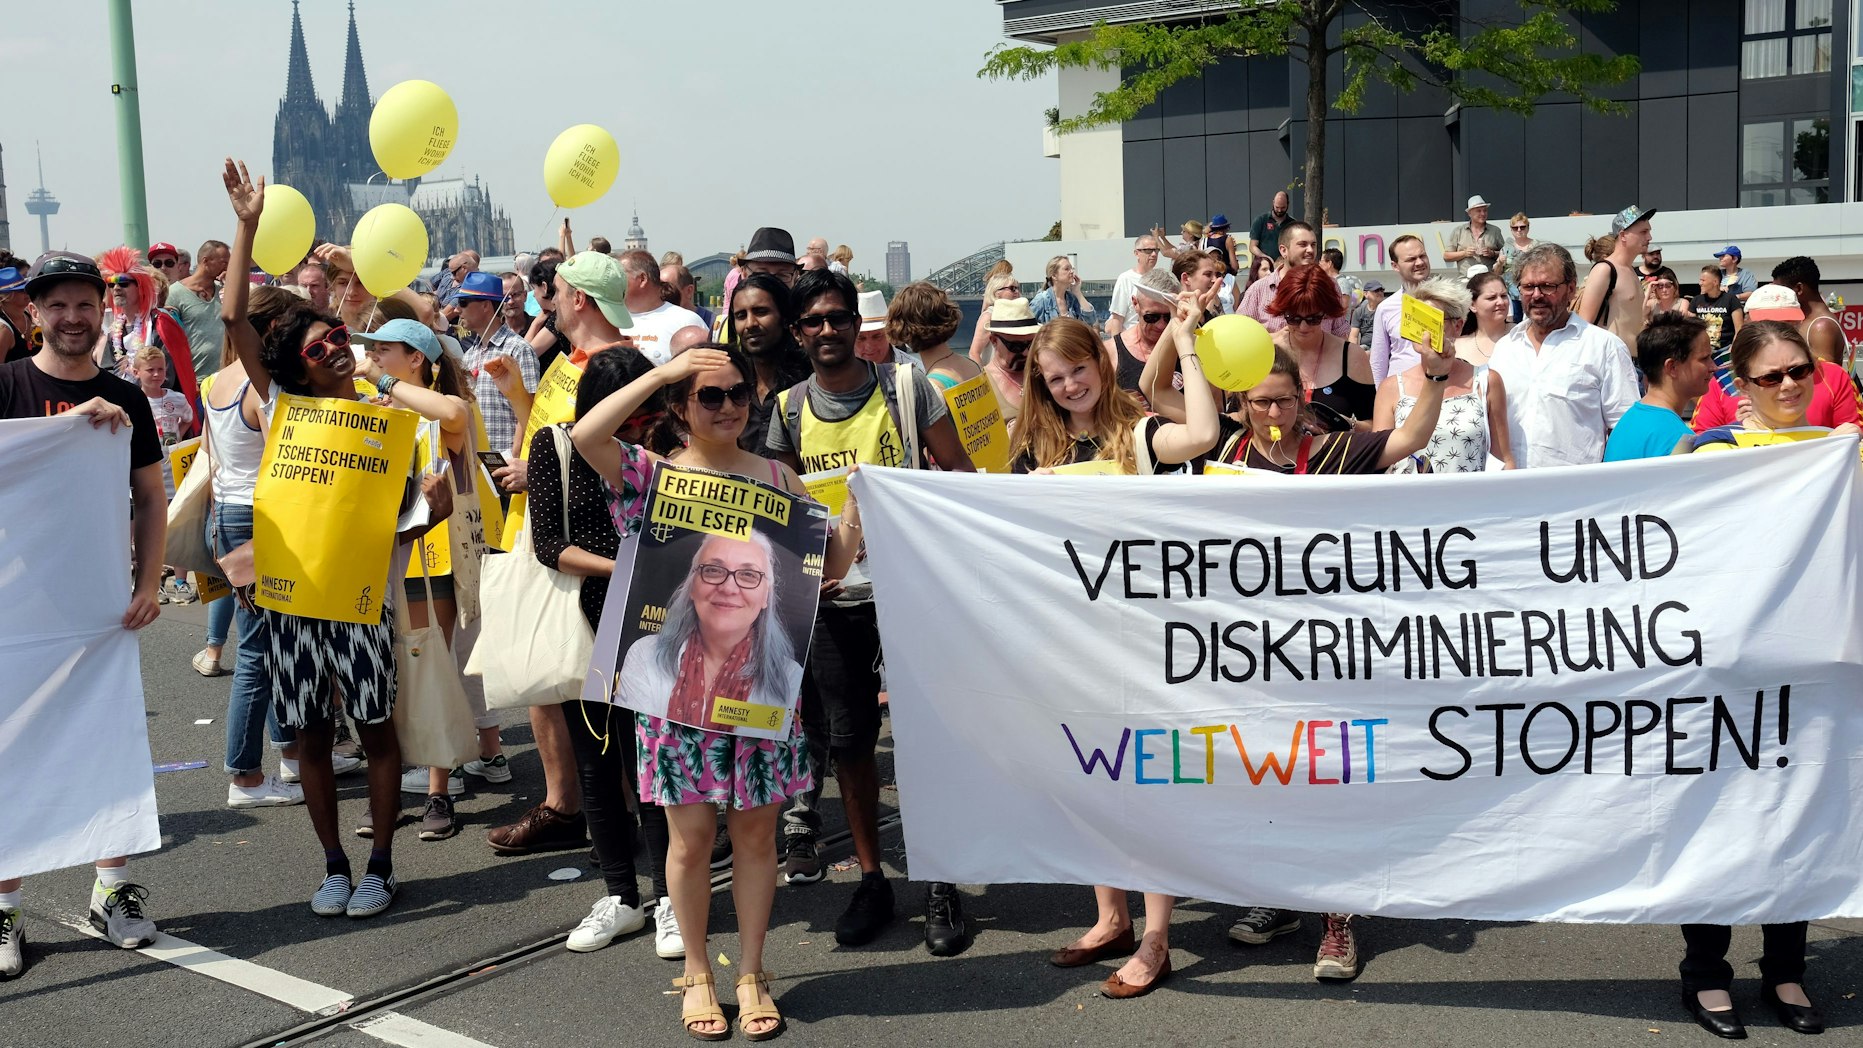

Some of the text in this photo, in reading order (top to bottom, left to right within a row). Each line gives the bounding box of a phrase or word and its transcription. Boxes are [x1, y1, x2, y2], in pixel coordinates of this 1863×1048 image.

[432, 125, 446, 138] ICH
[428, 137, 451, 149] FLIEGE
[583, 143, 597, 155] ICH
[424, 147, 446, 159] WOHIN
[579, 151, 601, 170] FLIEGE
[568, 167, 595, 189] ICH WILL
[573, 159, 596, 178] WOHIN
[286, 406, 389, 435] DEPORTATIONEN
[960, 410, 968, 424] IN
[282, 425, 295, 441] IN
[966, 431, 992, 457] STOPPEN!
[180, 450, 198, 469] ST
[277, 444, 389, 475] TSCHETSCHENIEN
[801, 448, 858, 475] MNESTY
[271, 462, 335, 486] STOPPEN!
[664, 474, 786, 521] FREIHEIT FÜR
[658, 500, 748, 536] IDIL ESER
[1064, 514, 1679, 601] VERFOLGUNG UND
[261, 574, 296, 593] AMNESTY
[261, 587, 292, 604] INTERNATIONAL
[1164, 600, 1704, 685] DISKRIMINIERUNG
[717, 712, 748, 723] INTERNATIONAL
[718, 704, 751, 717] AMNESTY
[1061, 684, 1791, 787] WELTWEIT STOPPEN!
